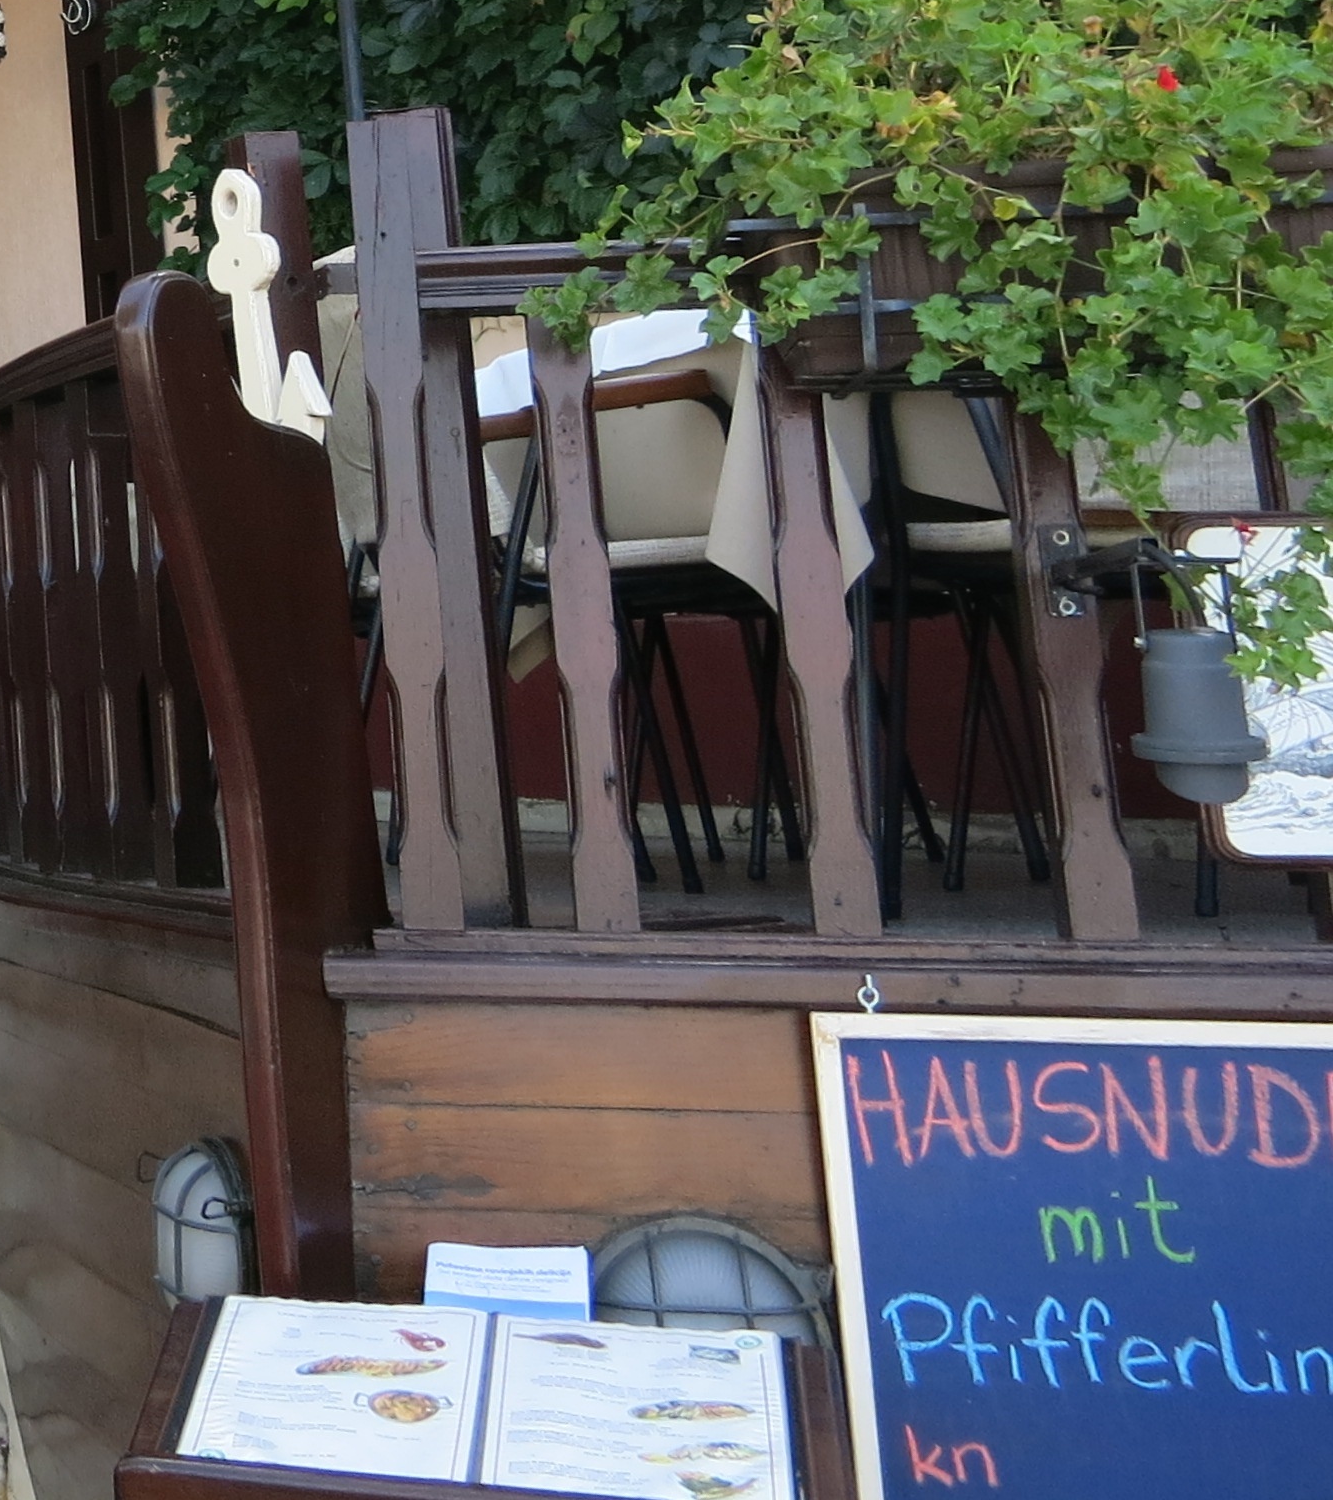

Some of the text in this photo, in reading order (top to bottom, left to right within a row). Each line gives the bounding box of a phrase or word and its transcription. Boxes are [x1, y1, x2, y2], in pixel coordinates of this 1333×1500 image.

[846, 1049, 1333, 1169] HAUSNUD
[1039, 1175, 1196, 1264] mit
[904, 1423, 1001, 1489] kn
